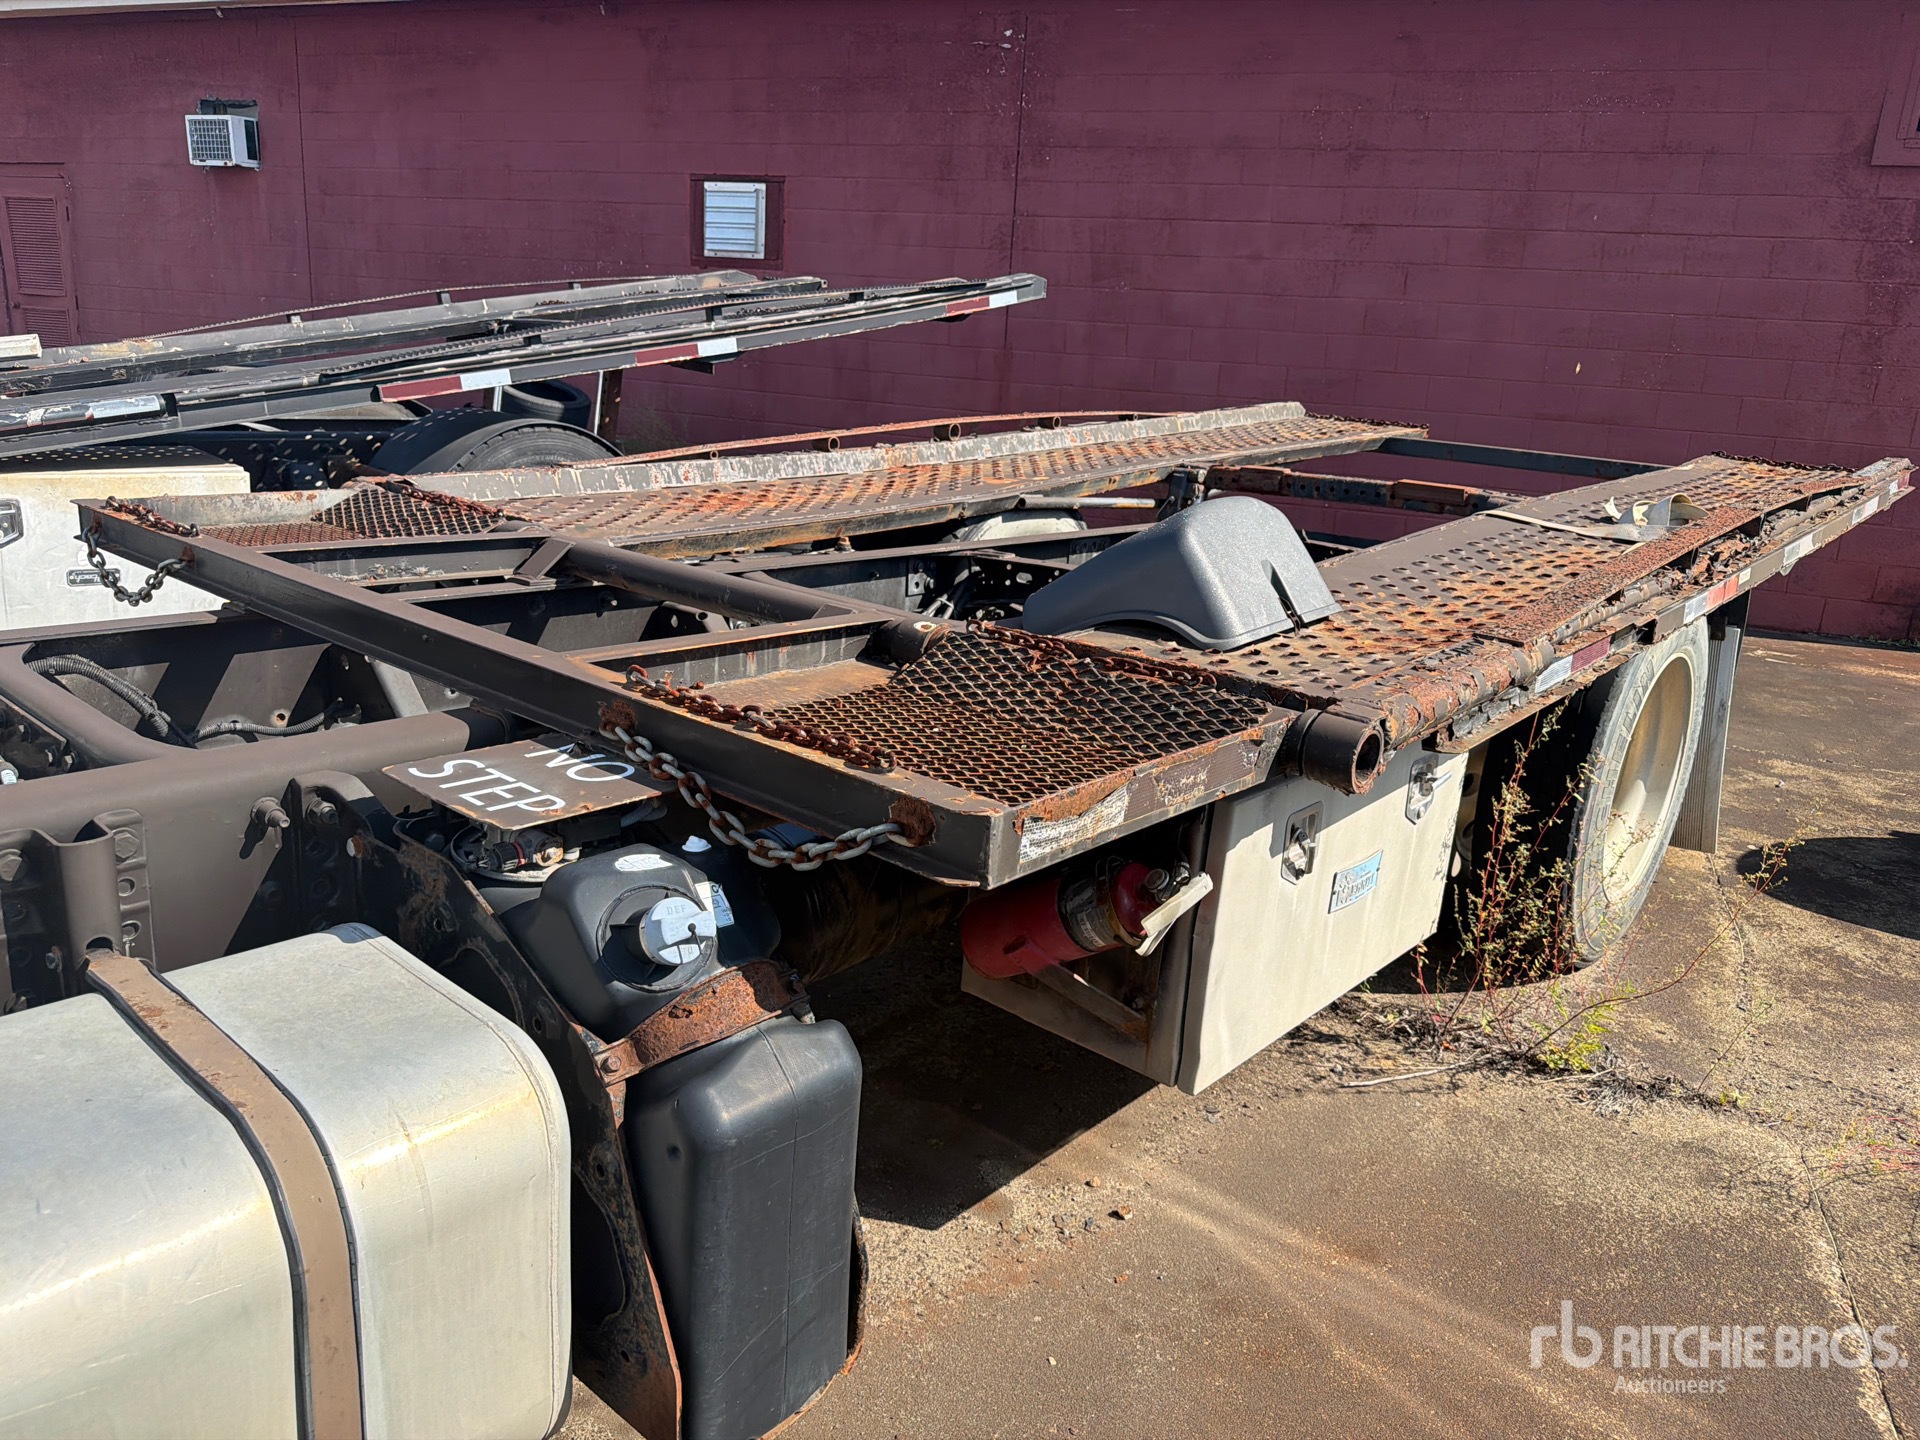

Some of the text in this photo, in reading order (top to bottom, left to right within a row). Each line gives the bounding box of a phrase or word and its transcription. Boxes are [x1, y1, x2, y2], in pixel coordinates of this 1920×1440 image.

[523, 743, 635, 782] NO
[408, 759, 566, 812] STEP
[666, 904, 687, 915] DEF
